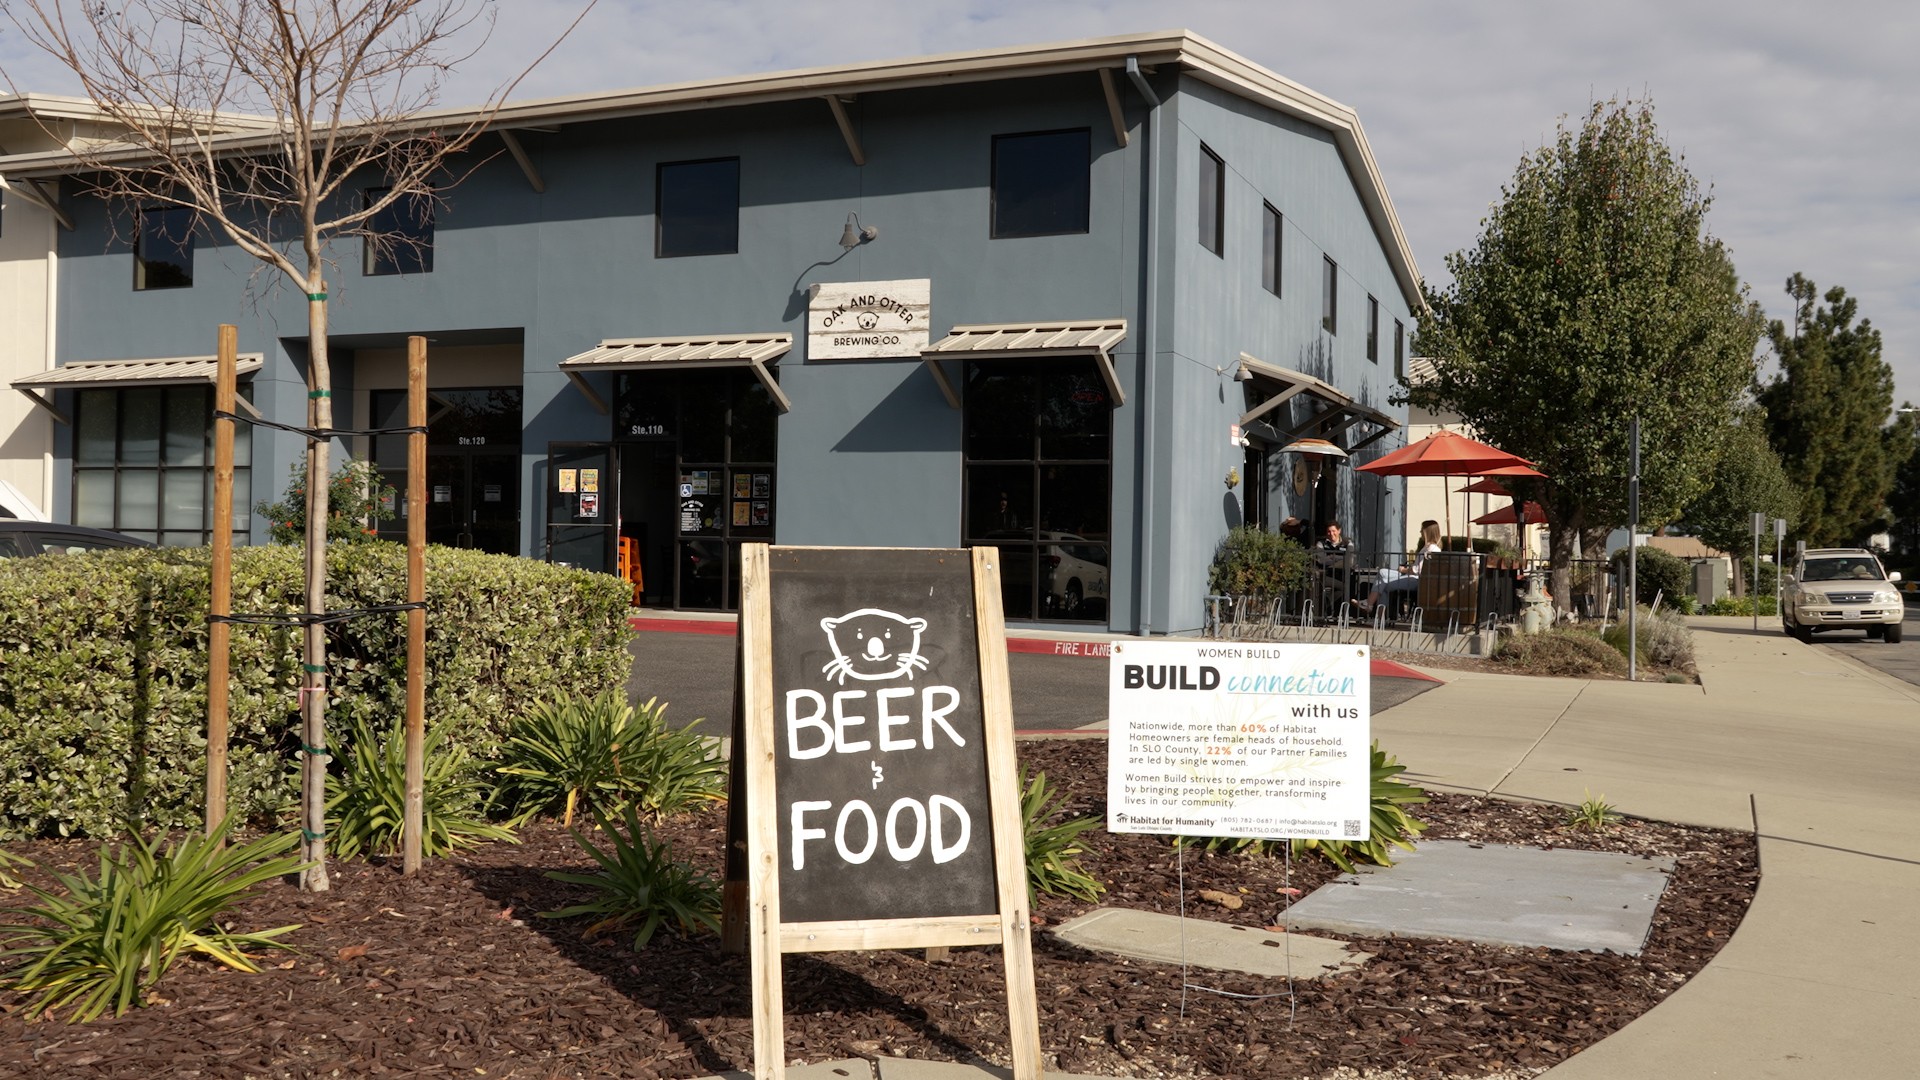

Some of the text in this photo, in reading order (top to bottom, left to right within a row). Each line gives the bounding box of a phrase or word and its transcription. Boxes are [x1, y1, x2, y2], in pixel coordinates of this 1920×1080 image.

[823, 295, 914, 328] OAK AND OTTER
[834, 336, 901, 346] BREWING CO.
[632, 425, 663, 435] Ste.110
[459, 437, 485, 445] Ste.120
[1055, 642, 1079, 655] FIRE
[1198, 649, 1281, 659] WOMEN BUILD
[1124, 665, 1355, 696] BUILD connection
[1291, 705, 1358, 718] with us
[786, 685, 966, 760] BEER
[1129, 722, 1185, 731] Nationwide,
[1217, 723, 1237, 732] than
[1240, 724, 1266, 733] 60%
[1283, 725, 1317, 733] Habitat
[1129, 733, 1191, 742] Homeowners
[1213, 734, 1245, 743] female
[1248, 735, 1275, 744] heads
[1279, 736, 1289, 744] of
[1293, 736, 1344, 745] household.
[1142, 745, 1161, 753] SLO
[1207, 747, 1232, 755] 22%
[1238, 747, 1248, 755] of
[1251, 748, 1267, 756] our
[1271, 748, 1306, 756] Partner
[1309, 749, 1347, 758] Families
[1147, 756, 1162, 764] led
[1164, 757, 1176, 766] by
[1180, 757, 1208, 767] single
[1212, 759, 1248, 767] women.
[1125, 774, 1160, 783] Women
[1164, 775, 1186, 783] Build
[1190, 775, 1222, 783] strives
[1240, 777, 1284, 787] empower
[1288, 777, 1306, 786] and
[1309, 778, 1341, 789] inspire
[1125, 786, 1327, 799] by bringing people together, transforming
[1125, 797, 1146, 805] lives
[1182, 799, 1237, 809] community.
[1130, 816, 1215, 827] Habitat for Humanity
[1279, 819, 1337, 827] info@habitatslo.org
[791, 794, 971, 871] FOOD
[1230, 827, 1330, 835] HABITATSLO.ORG/WOMENBUILD
